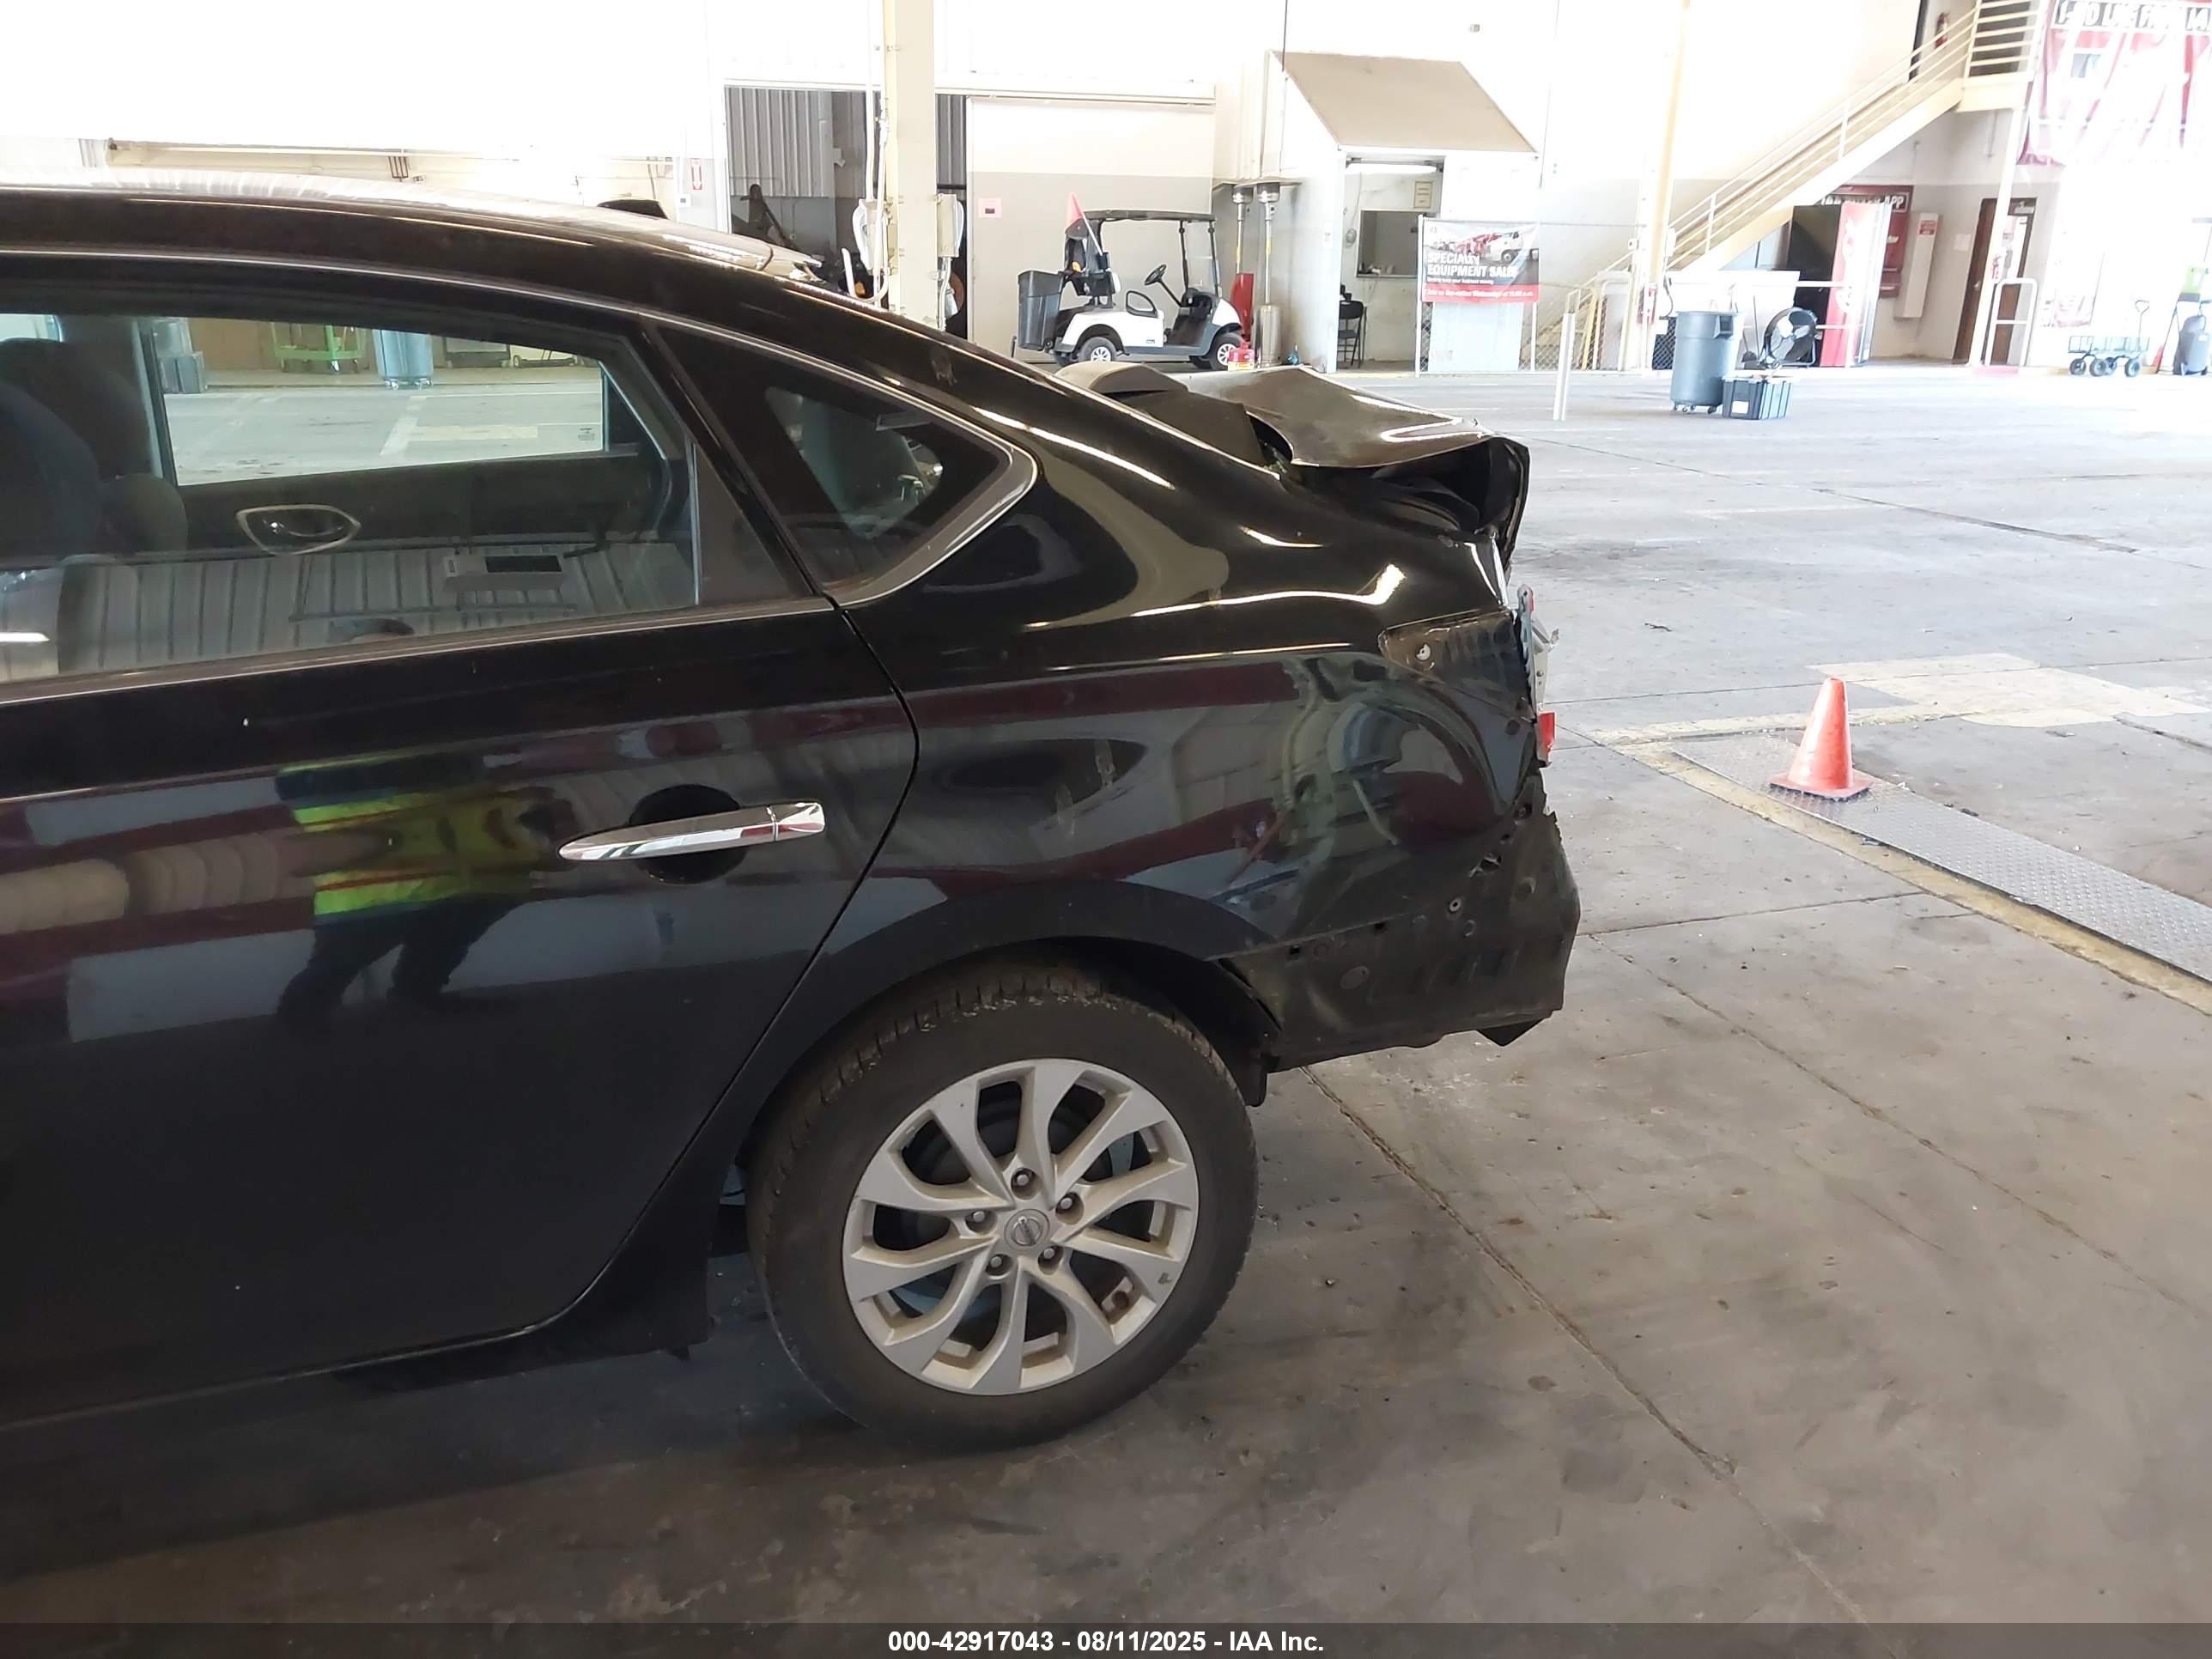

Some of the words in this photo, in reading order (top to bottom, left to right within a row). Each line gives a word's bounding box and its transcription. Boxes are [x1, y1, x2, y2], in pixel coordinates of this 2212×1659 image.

[1884, 195, 1905, 209] APP
[1427, 252, 1480, 265] SPECIALTY
[1427, 264, 1487, 277] EQUIPMENT
